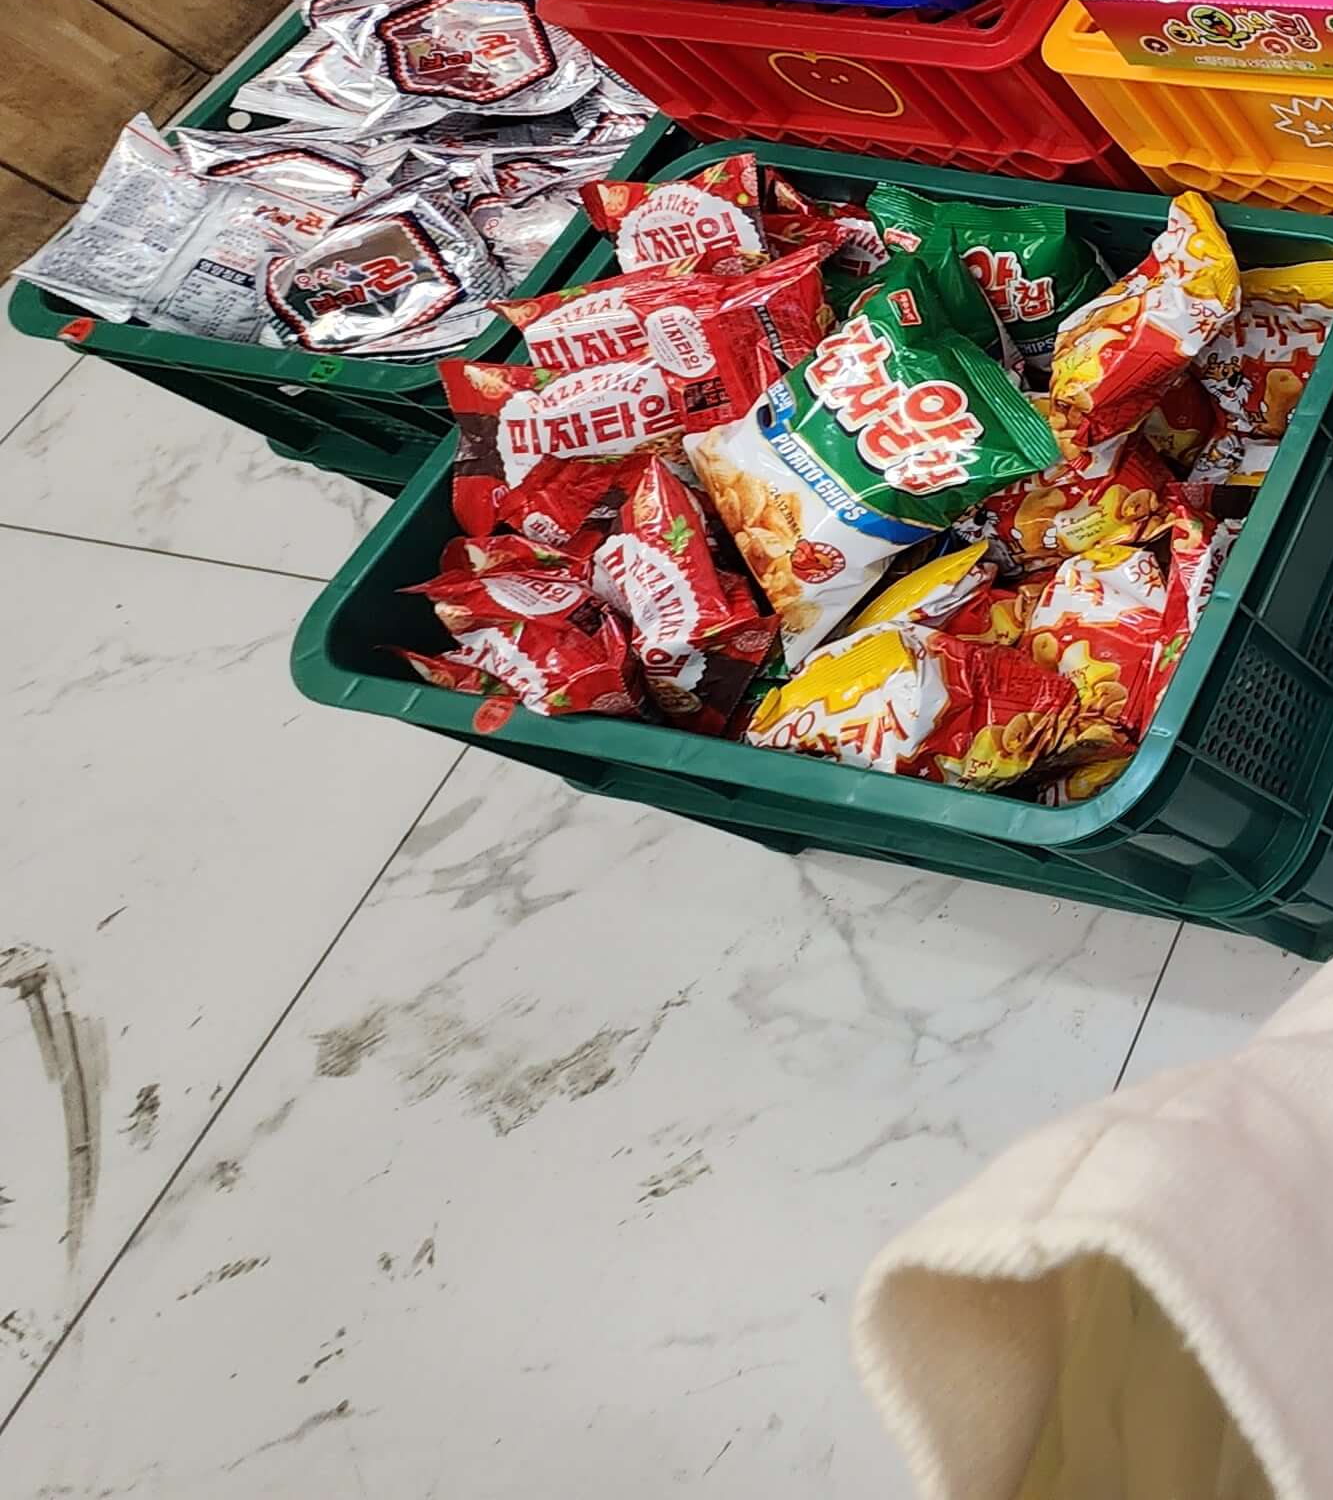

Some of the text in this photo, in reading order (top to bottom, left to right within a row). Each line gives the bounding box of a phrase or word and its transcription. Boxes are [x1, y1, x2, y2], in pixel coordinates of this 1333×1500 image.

[963, 247, 1056, 317] 알칩
[529, 319, 649, 371] 피자타
[505, 392, 689, 458] 피자타임
[768, 431, 821, 490] POTATO
[813, 474, 866, 523] CHIPS
